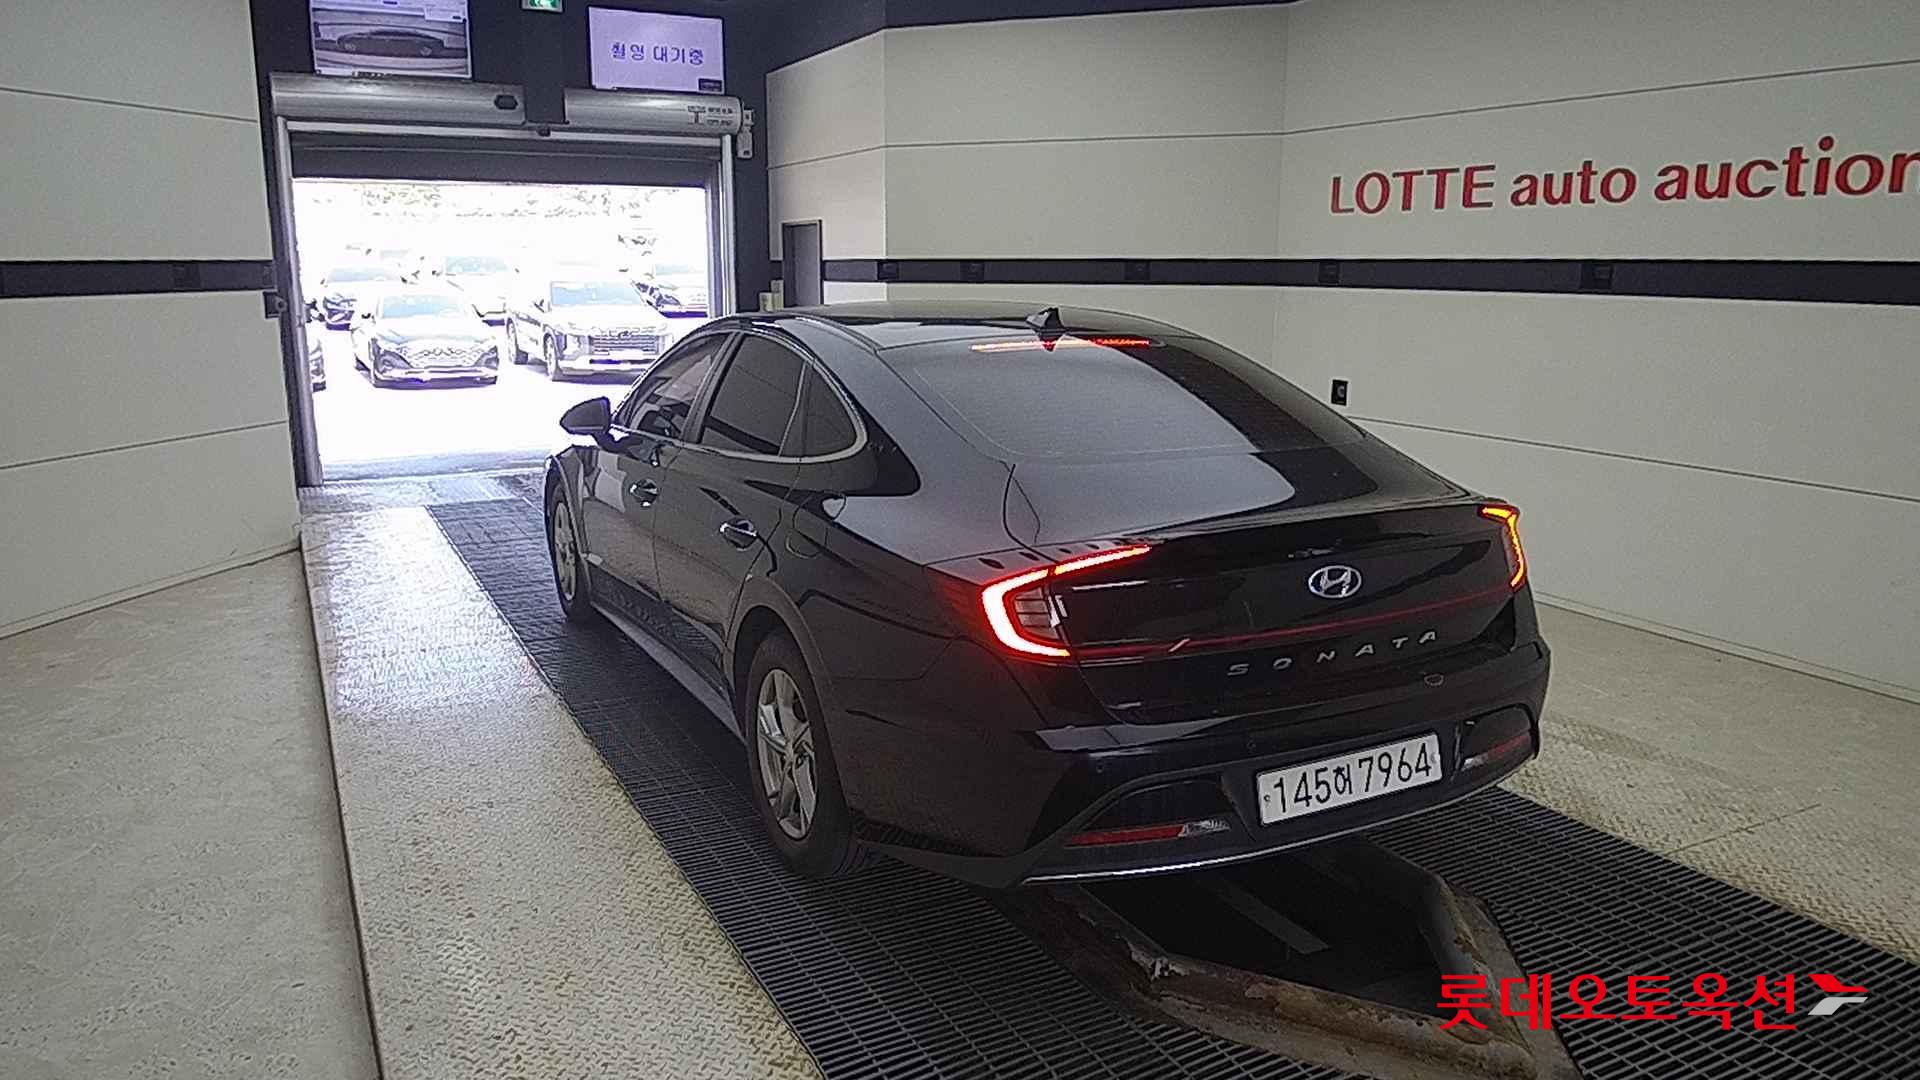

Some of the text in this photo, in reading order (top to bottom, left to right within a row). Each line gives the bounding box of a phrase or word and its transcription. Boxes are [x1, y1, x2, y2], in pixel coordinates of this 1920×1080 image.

[653, 45, 704, 65] 대기중
[1331, 164, 1496, 214] LOTTE
[1510, 160, 1637, 207] auto
[1227, 630, 1436, 676] SONATA
